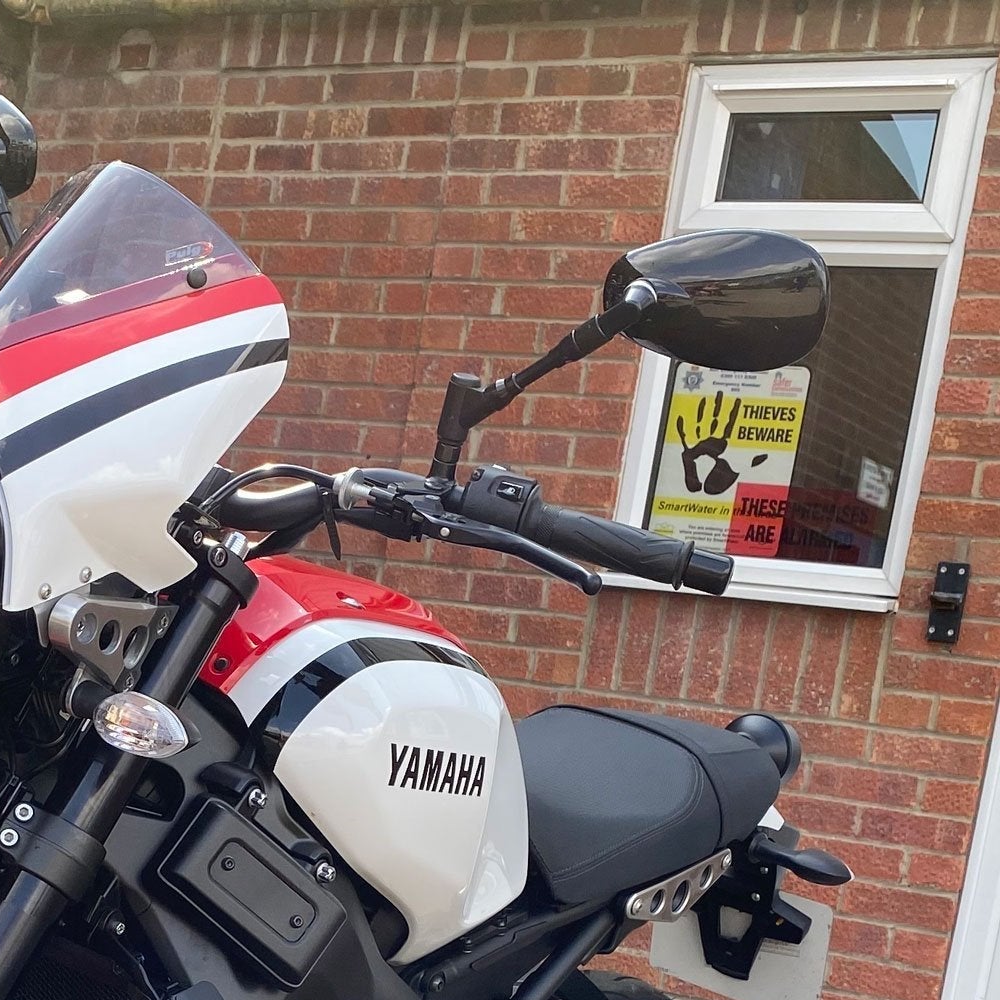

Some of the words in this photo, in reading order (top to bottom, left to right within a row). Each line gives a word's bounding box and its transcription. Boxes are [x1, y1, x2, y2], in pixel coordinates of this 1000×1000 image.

[743, 404, 797, 422] THIEVES
[737, 425, 793, 443] BEWARE
[658, 501, 718, 515] SmartWater
[719, 505, 730, 516] in
[741, 497, 787, 518] THESE
[745, 524, 776, 544] ARE
[388, 743, 486, 797] YAMAHA
